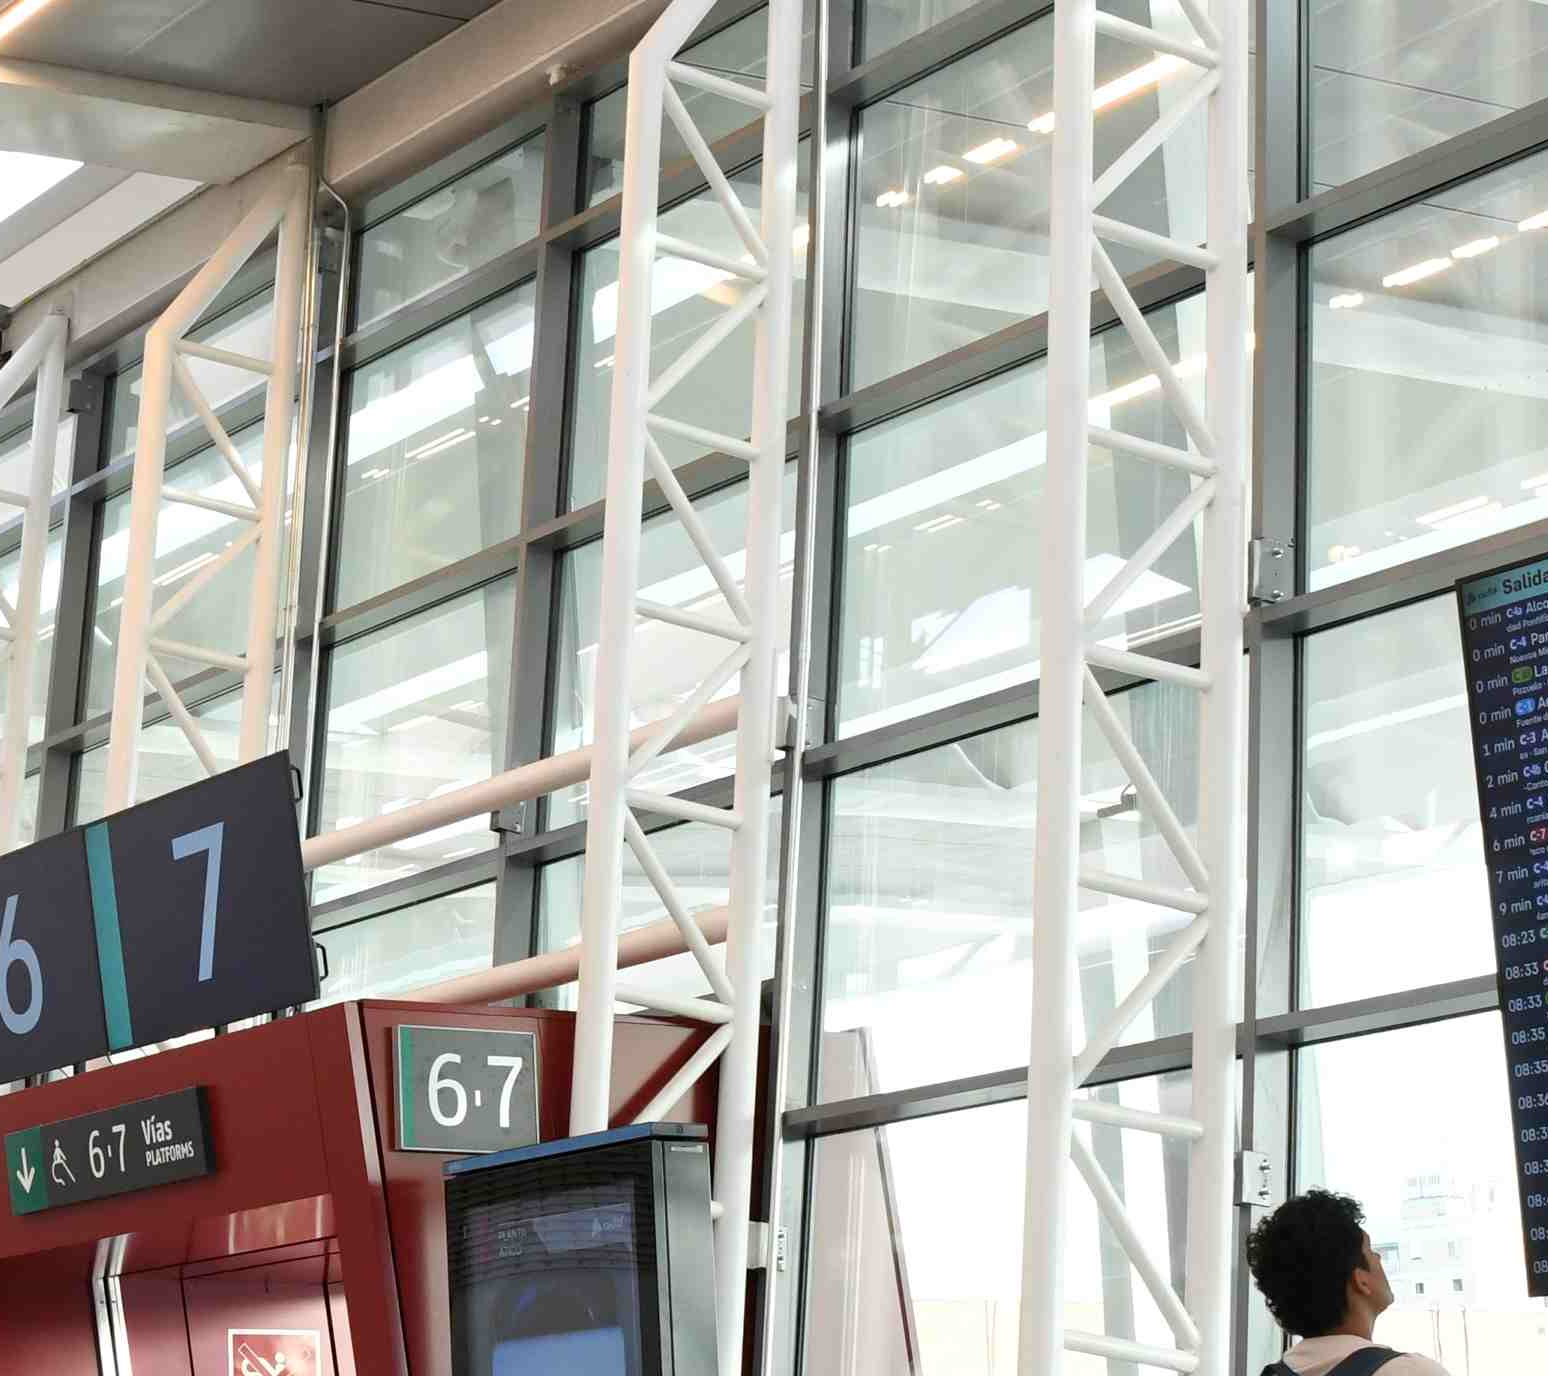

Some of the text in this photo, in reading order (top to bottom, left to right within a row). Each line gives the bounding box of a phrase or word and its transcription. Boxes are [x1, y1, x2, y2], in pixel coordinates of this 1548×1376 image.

[171, 822, 225, 983] 7
[1500, 928, 1536, 948] 08:23
[1507, 993, 1543, 1013] 08:33
[1510, 1025, 1546, 1045] 08:35
[141, 1115, 173, 1146] Vías
[144, 1140, 195, 1167] PLATFORMS
